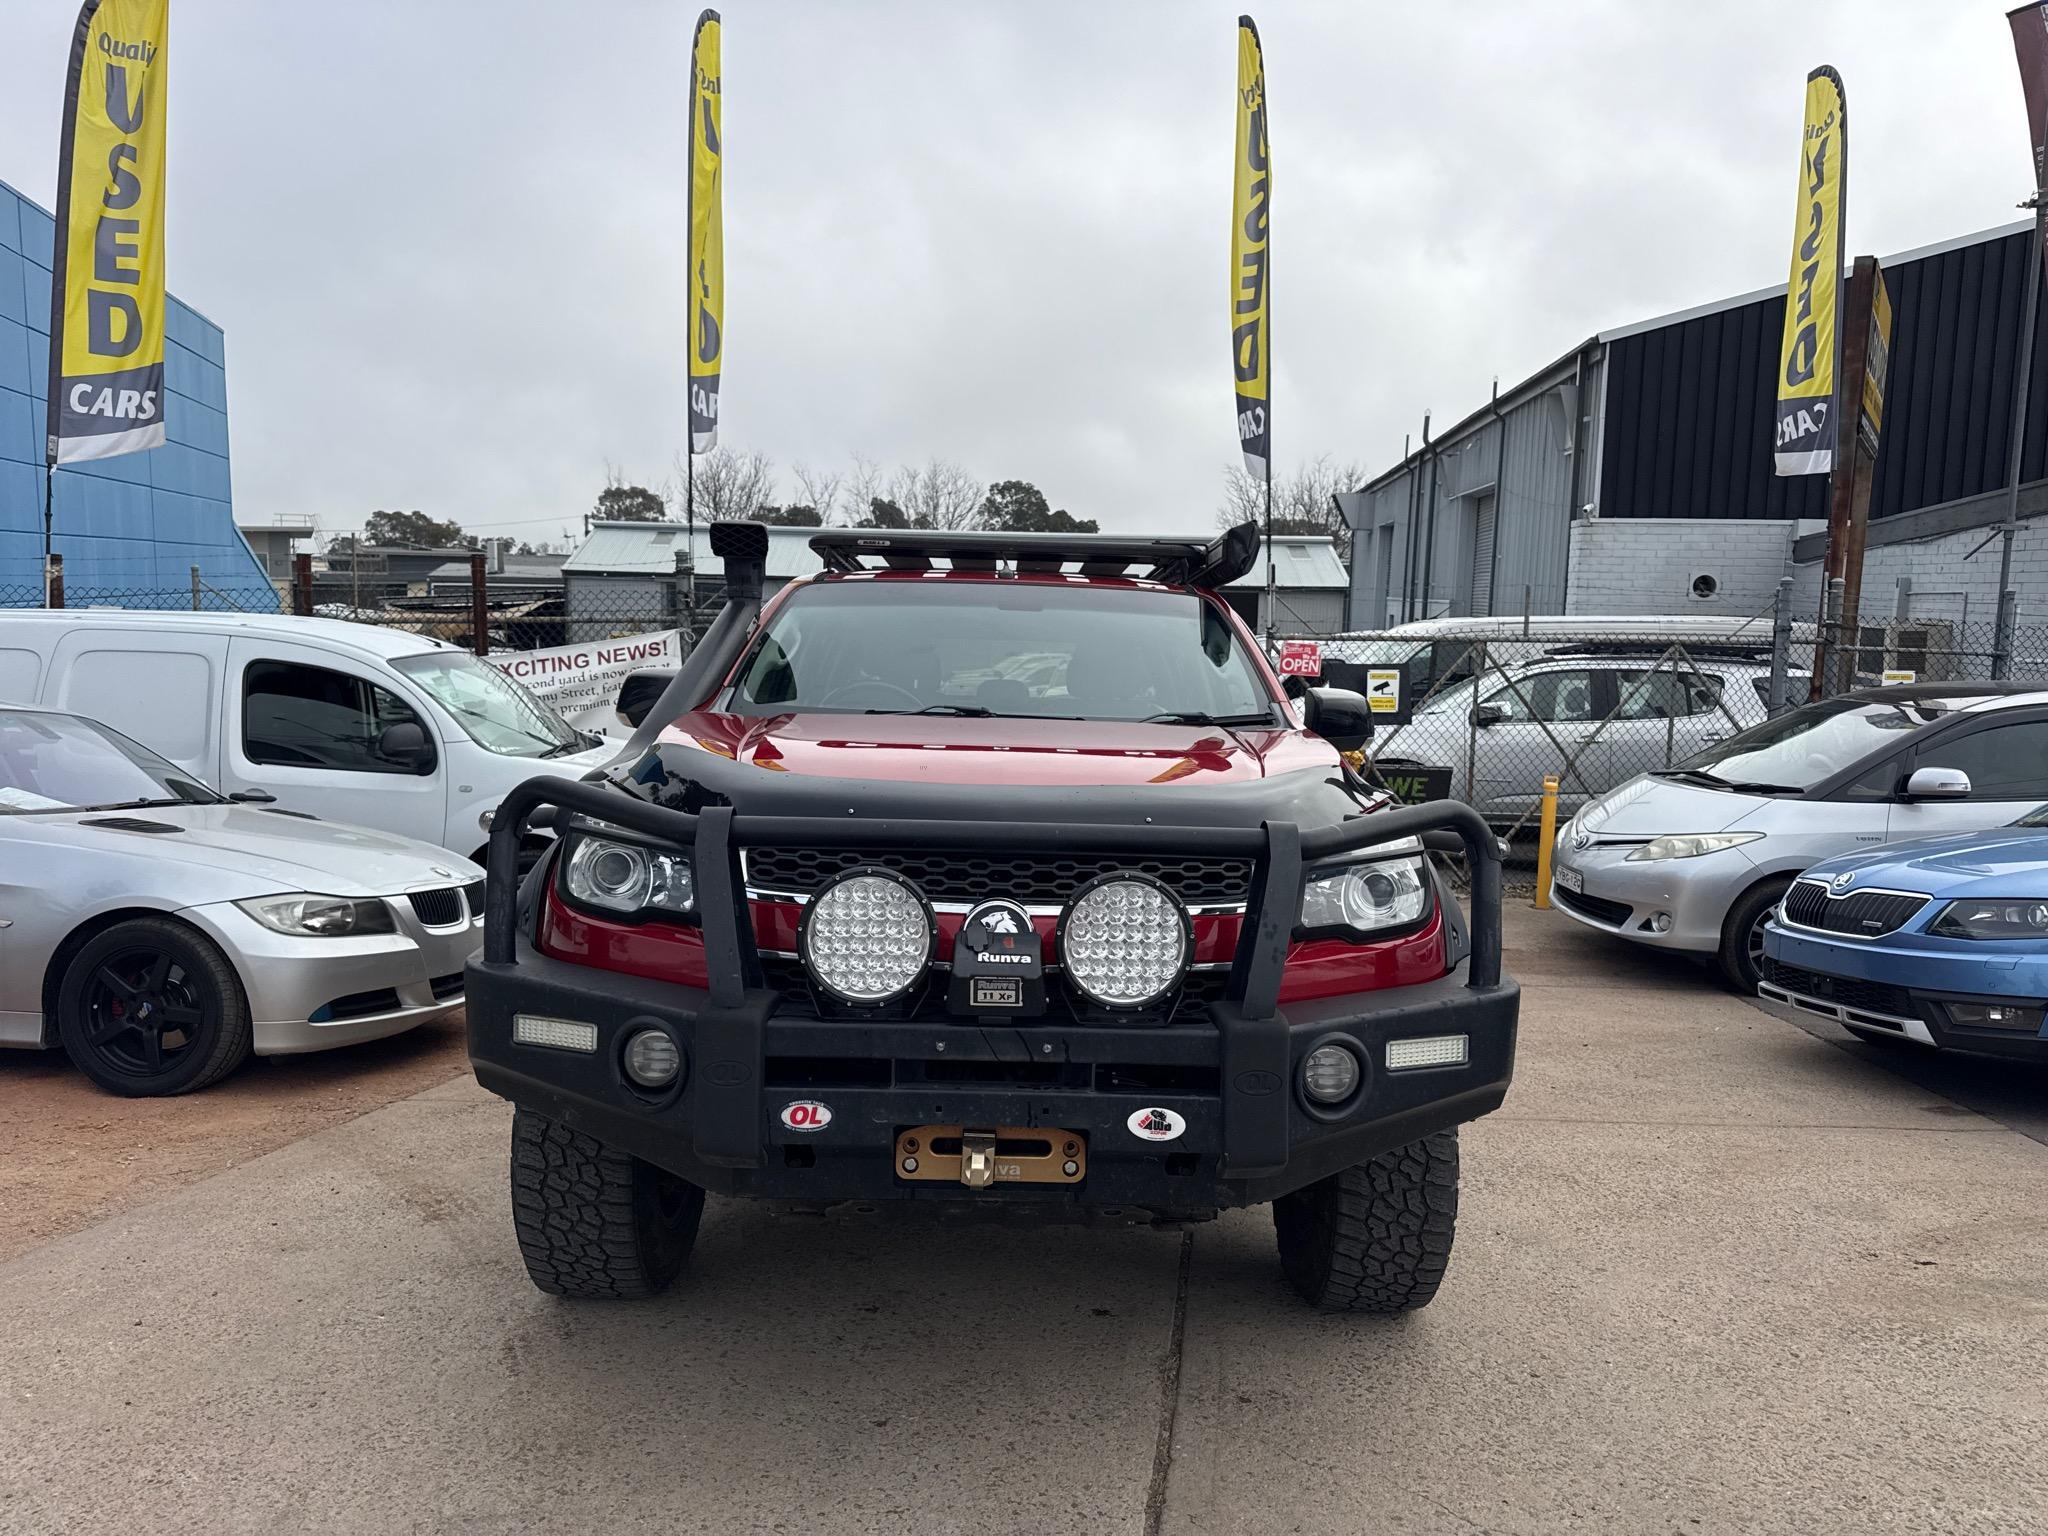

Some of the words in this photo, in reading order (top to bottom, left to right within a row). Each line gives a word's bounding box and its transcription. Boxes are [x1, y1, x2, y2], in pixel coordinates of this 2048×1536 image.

[88, 62, 144, 358] USED
[69, 383, 157, 421] CARS
[499, 653, 590, 678] XCITING
[597, 640, 668, 666] NEWS!
[1282, 657, 1319, 673] OPEN
[559, 671, 586, 688] yard
[589, 669, 599, 681] is
[561, 686, 600, 699] Street,
[560, 698, 610, 717] premium
[1387, 776, 1429, 797] WE
[977, 951, 1032, 964] Runva
[789, 1106, 822, 1126] OL
